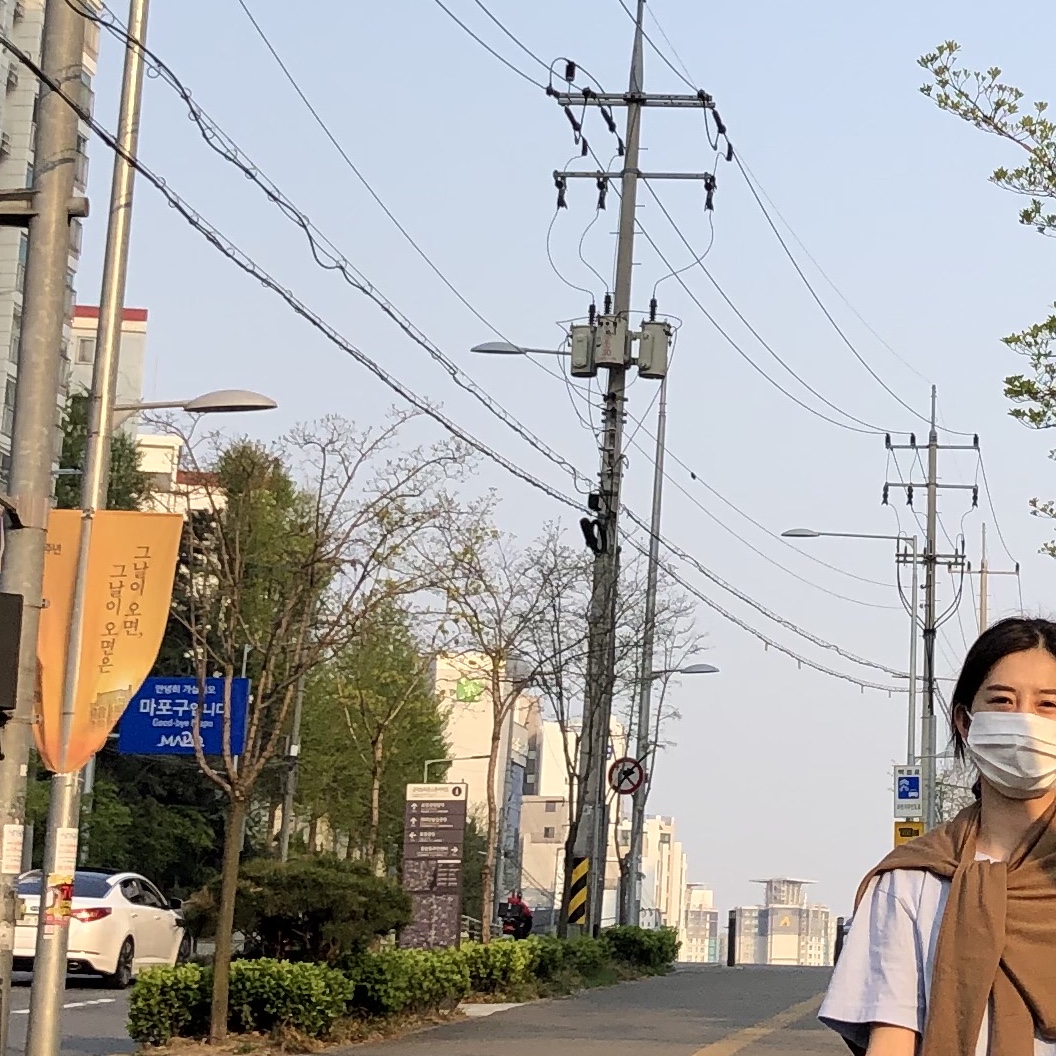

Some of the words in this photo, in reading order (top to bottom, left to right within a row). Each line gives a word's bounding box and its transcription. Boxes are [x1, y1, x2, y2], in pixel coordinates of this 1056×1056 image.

[106, 565, 127, 615] 그날이
[129, 546, 151, 596] 그날이
[123, 602, 143, 638] 오면,
[98, 622, 119, 673] 오면은
[155, 684, 181, 694] 안녕히
